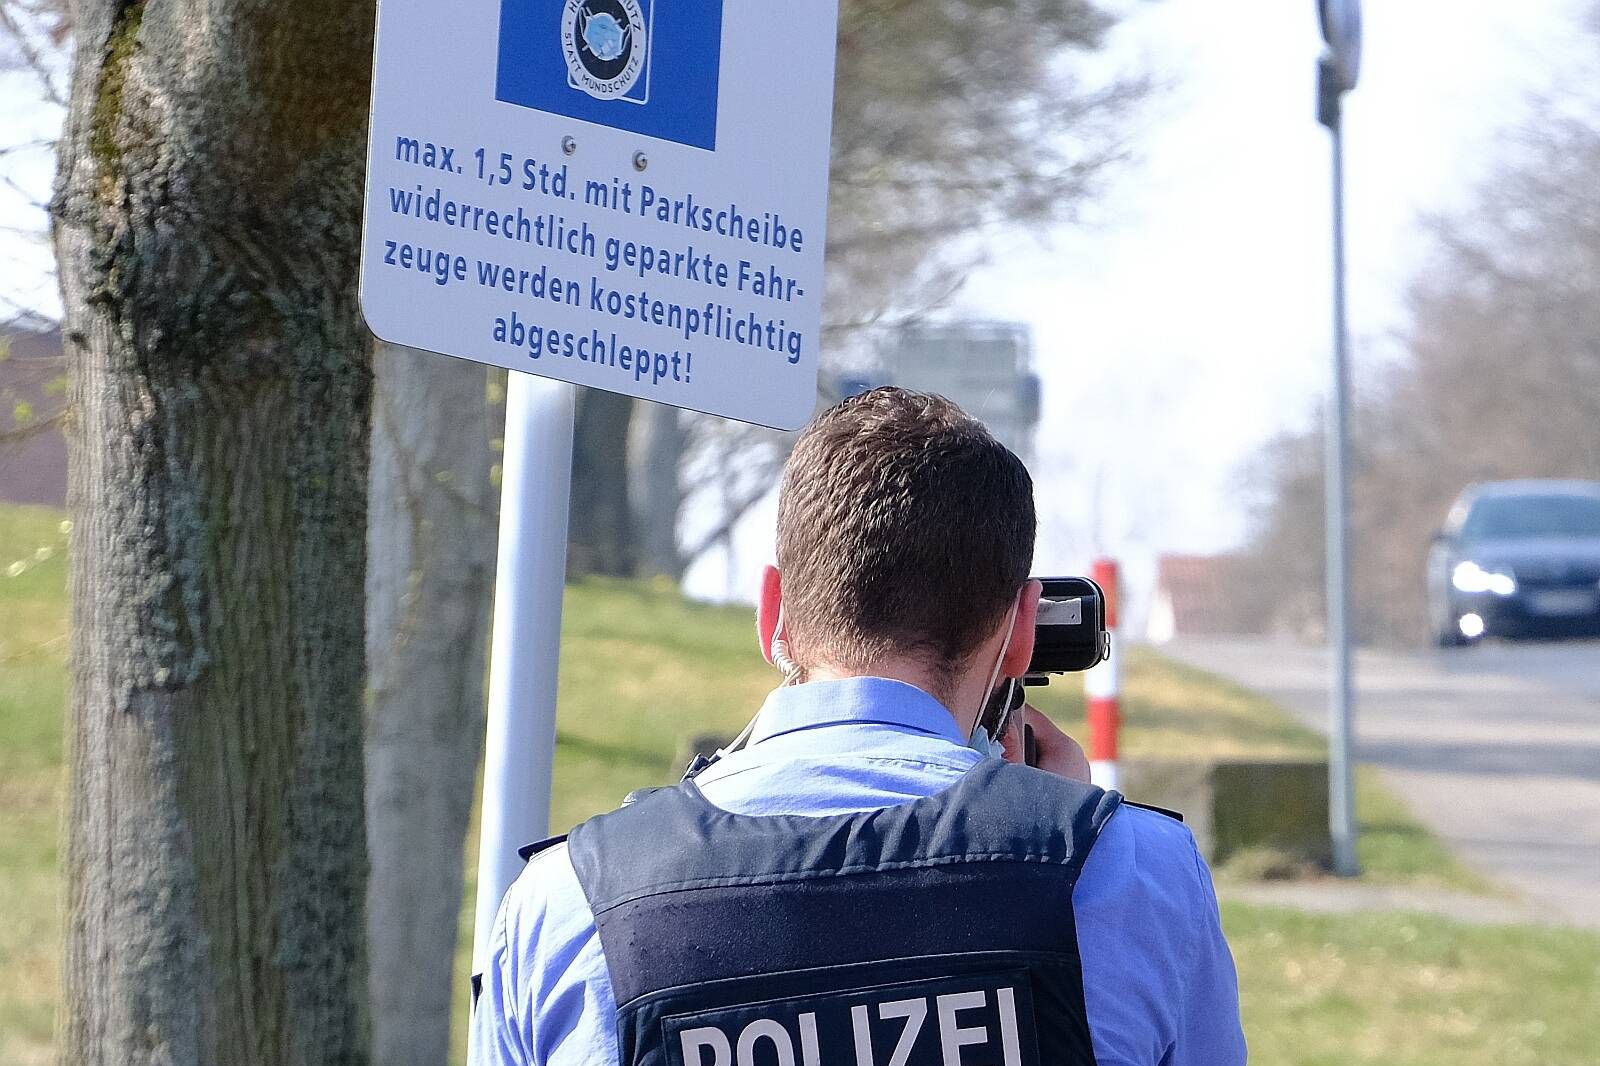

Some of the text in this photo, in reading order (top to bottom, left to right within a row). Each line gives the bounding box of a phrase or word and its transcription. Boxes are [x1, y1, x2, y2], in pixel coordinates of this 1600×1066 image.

[565, 32, 639, 93] STATT MUNDSCHUTZ
[389, 185, 804, 301] widerrechtlich geparkte Fahr-
[395, 136, 803, 252] max. 1,5 Std. mit Parkscheibe
[384, 240, 802, 364] zeuge werden kostenpflichtig
[493, 311, 692, 385] abgeschleppt!
